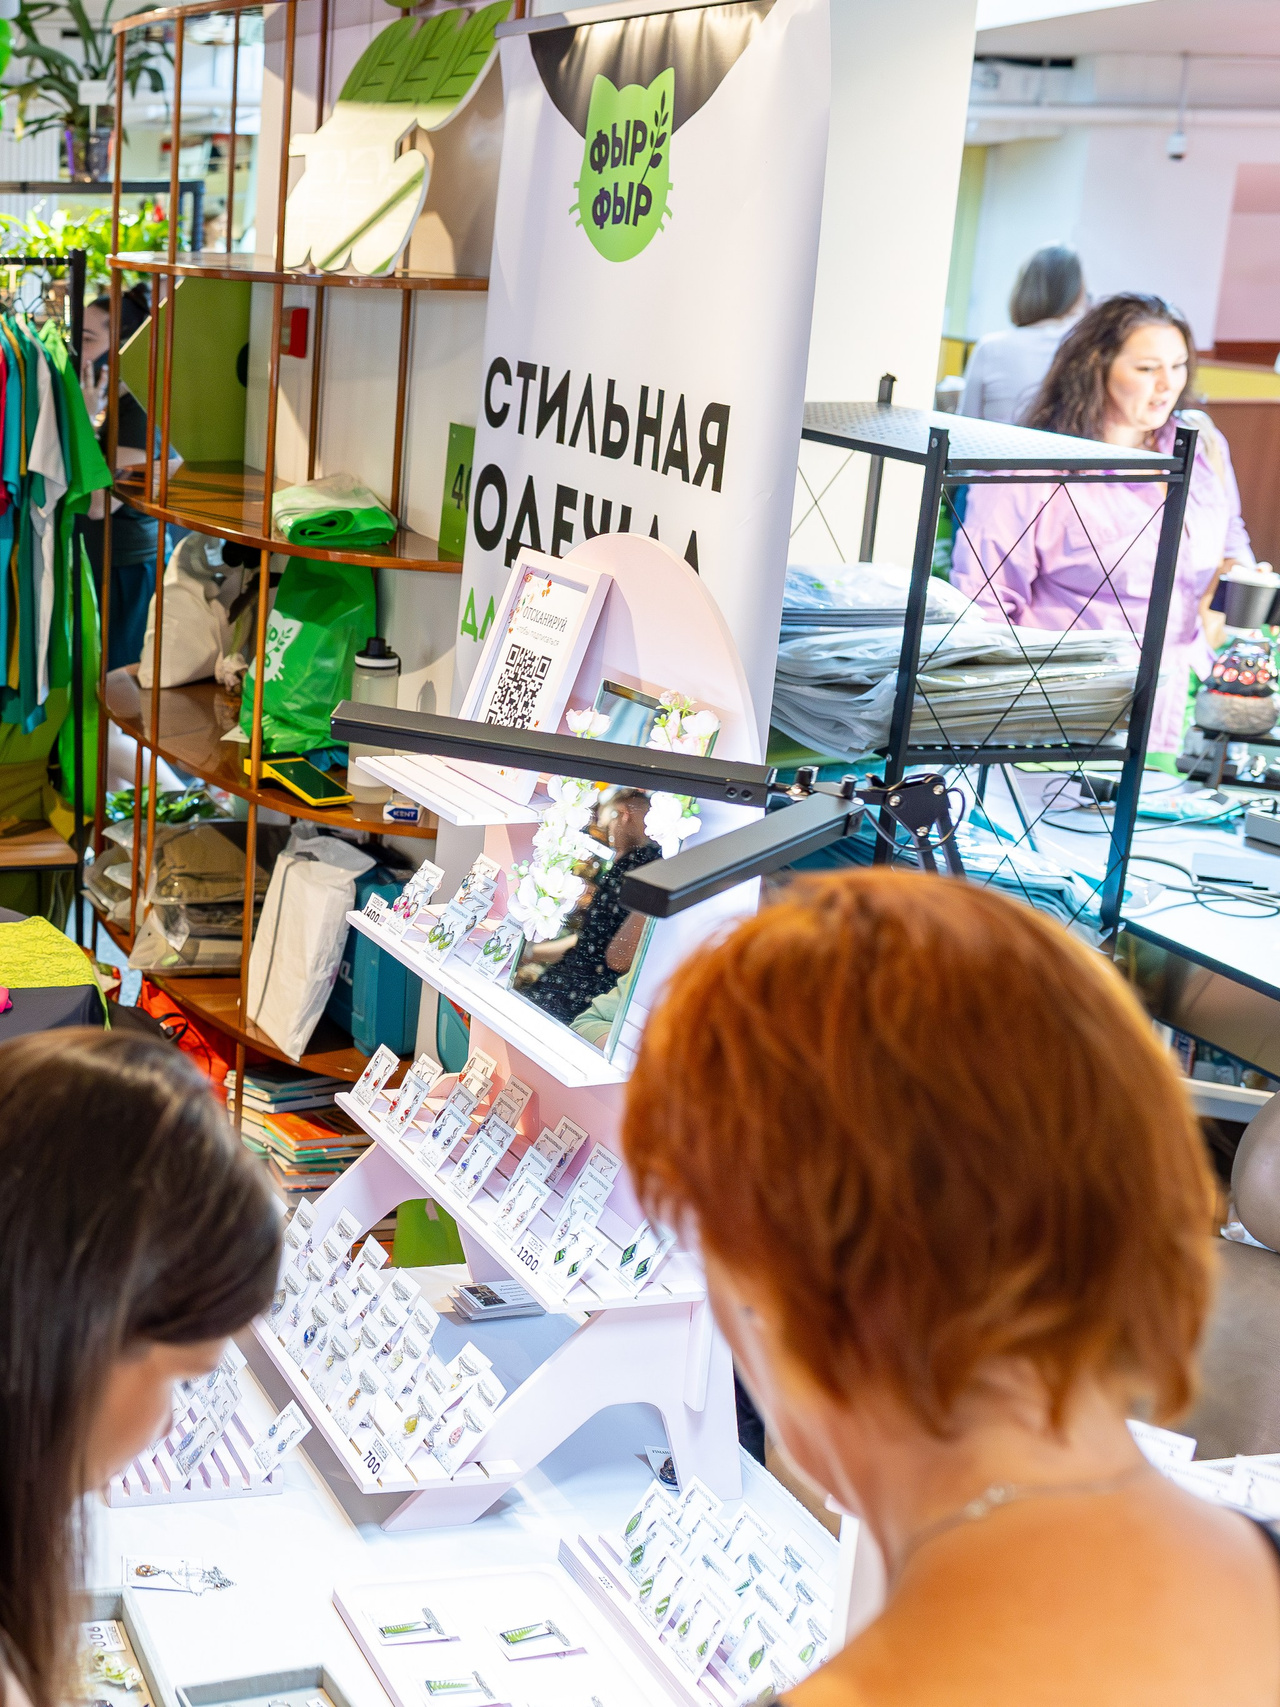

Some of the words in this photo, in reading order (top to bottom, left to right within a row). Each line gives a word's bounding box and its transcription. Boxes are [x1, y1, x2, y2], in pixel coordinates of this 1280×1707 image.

[589, 120, 648, 175] ФЫР
[592, 182, 653, 230] ФЫР
[484, 356, 731, 494] СТИЛЬНАЯ
[522, 605, 568, 633] ОТСКАНИРУЙ
[392, 809, 416, 818] KENT
[363, 905, 381, 924] 1400
[516, 1246, 539, 1271] 1200
[363, 1450, 381, 1475] 700
